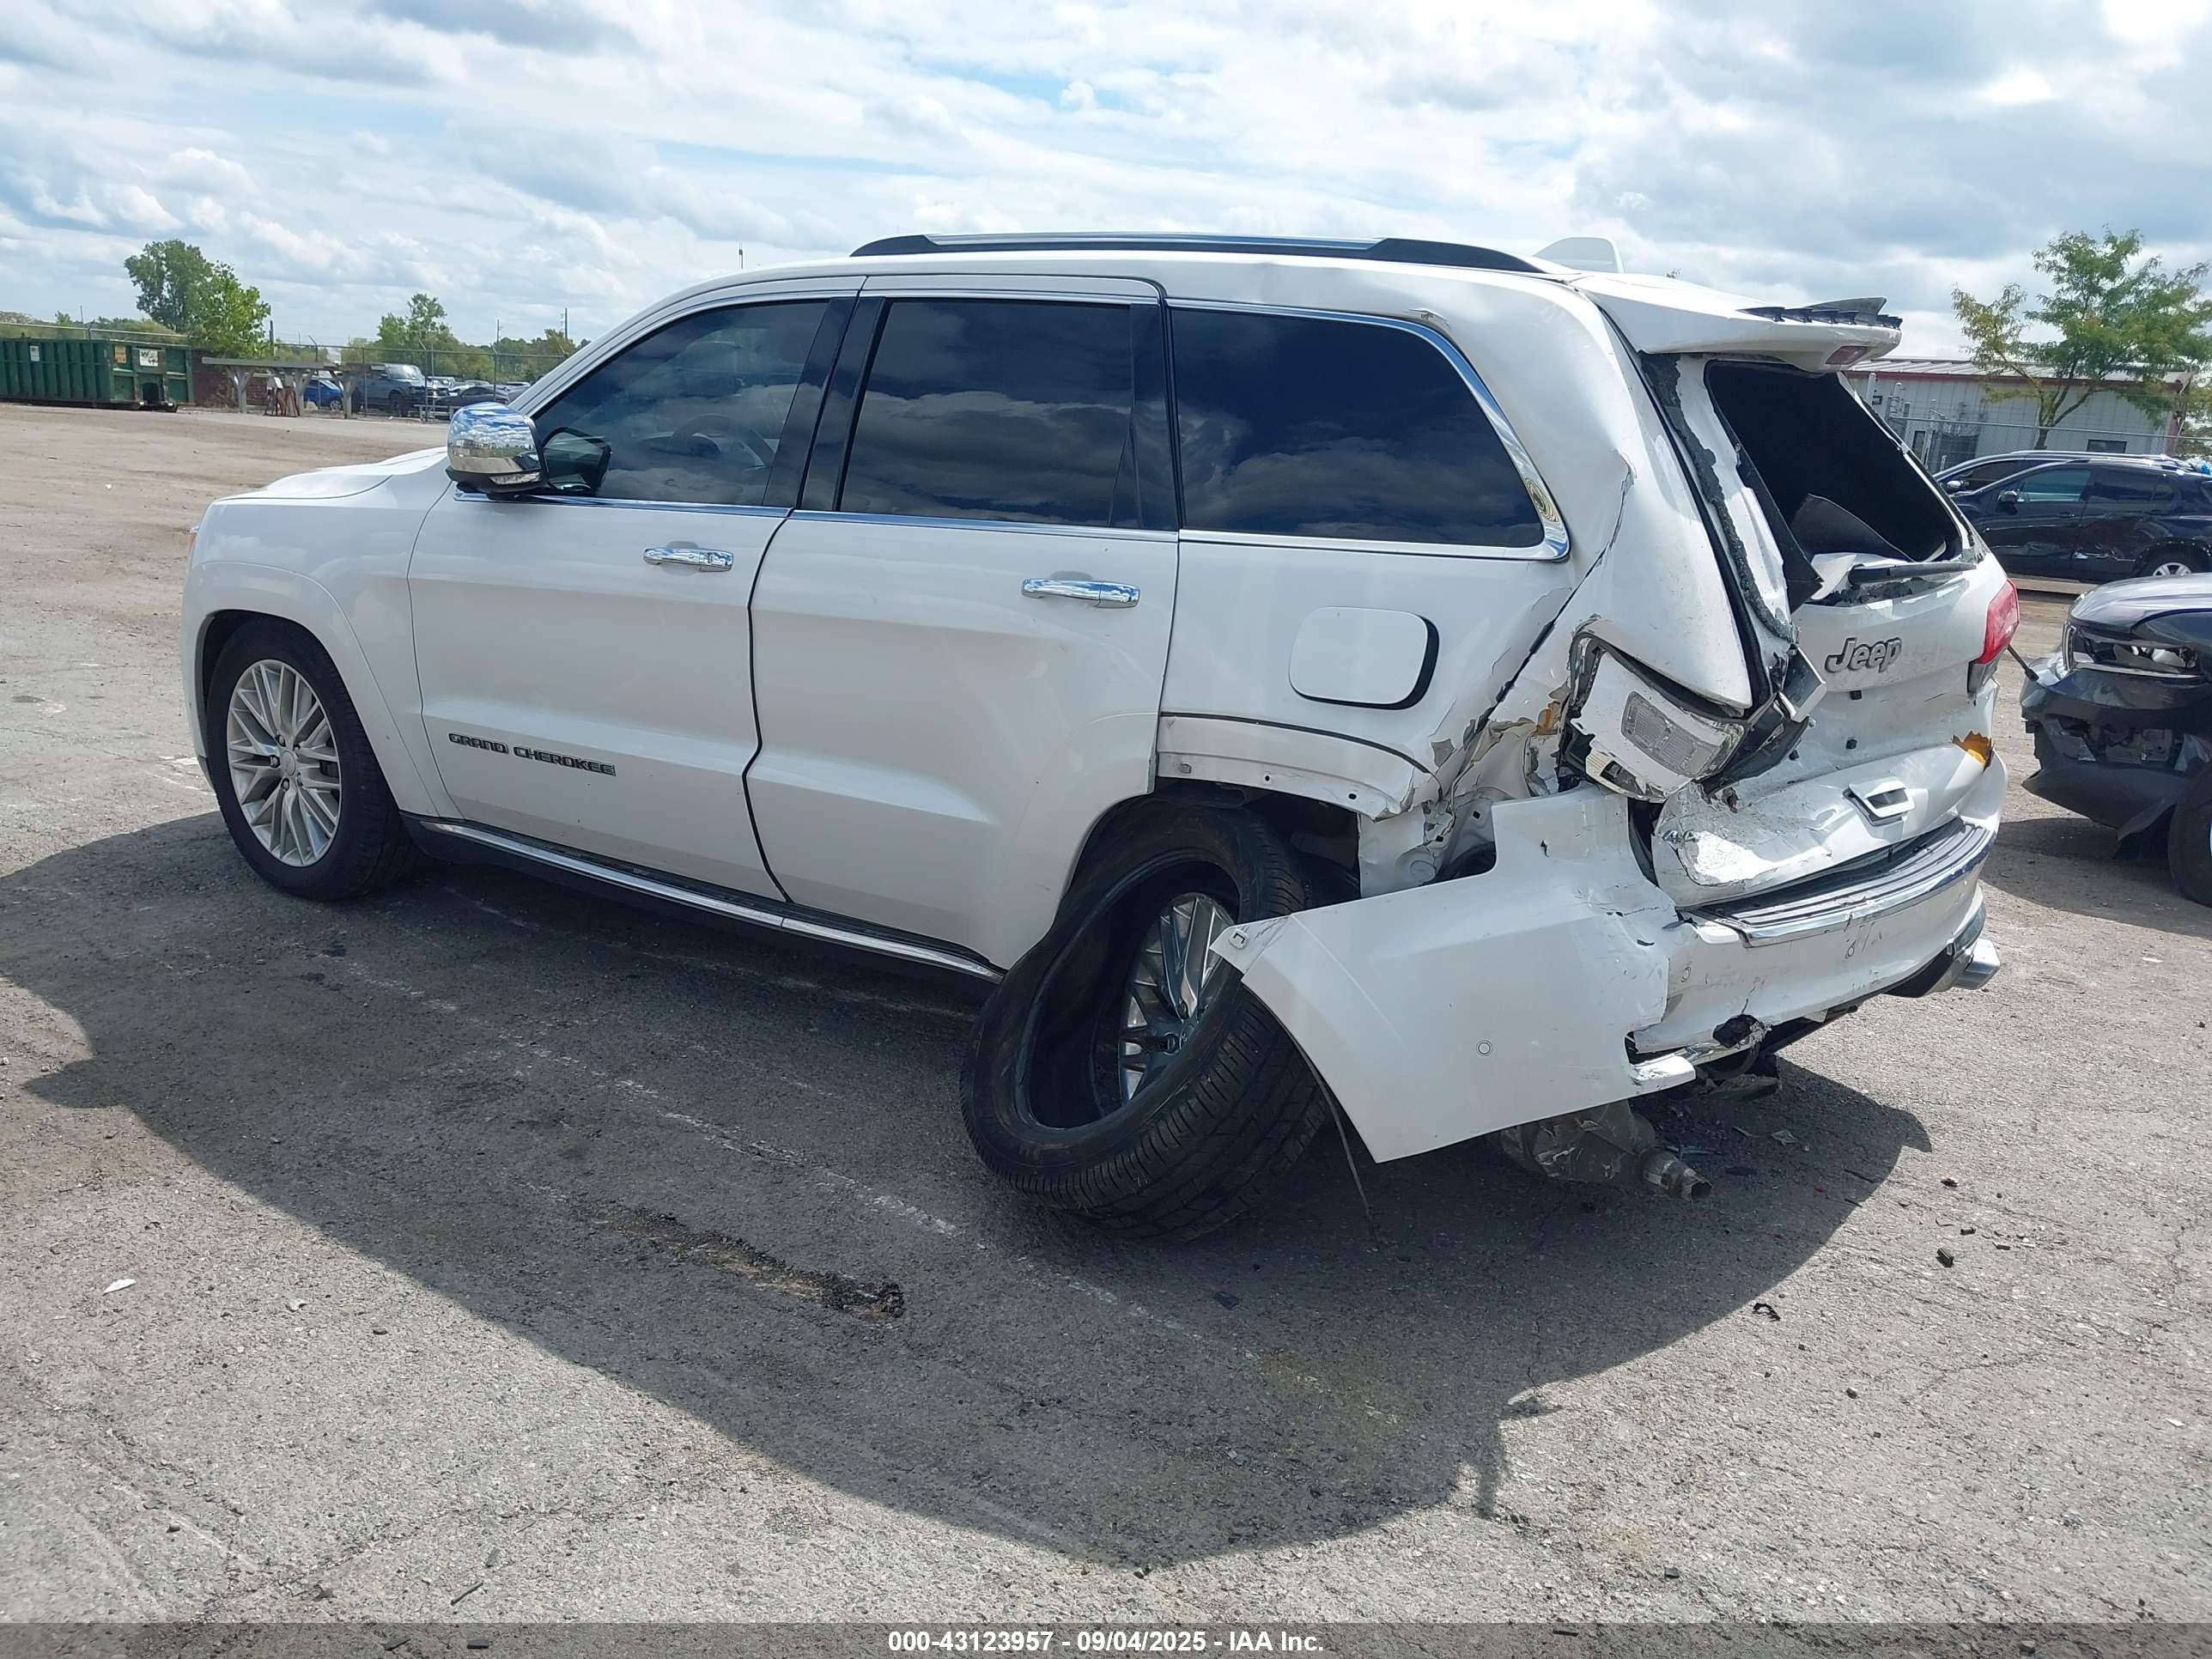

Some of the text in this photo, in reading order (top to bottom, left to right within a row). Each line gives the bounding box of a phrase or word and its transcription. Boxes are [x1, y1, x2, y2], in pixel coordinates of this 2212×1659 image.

[1825, 636, 1902, 673] Jeep
[448, 732, 617, 776] GRAND CHEROKEE
